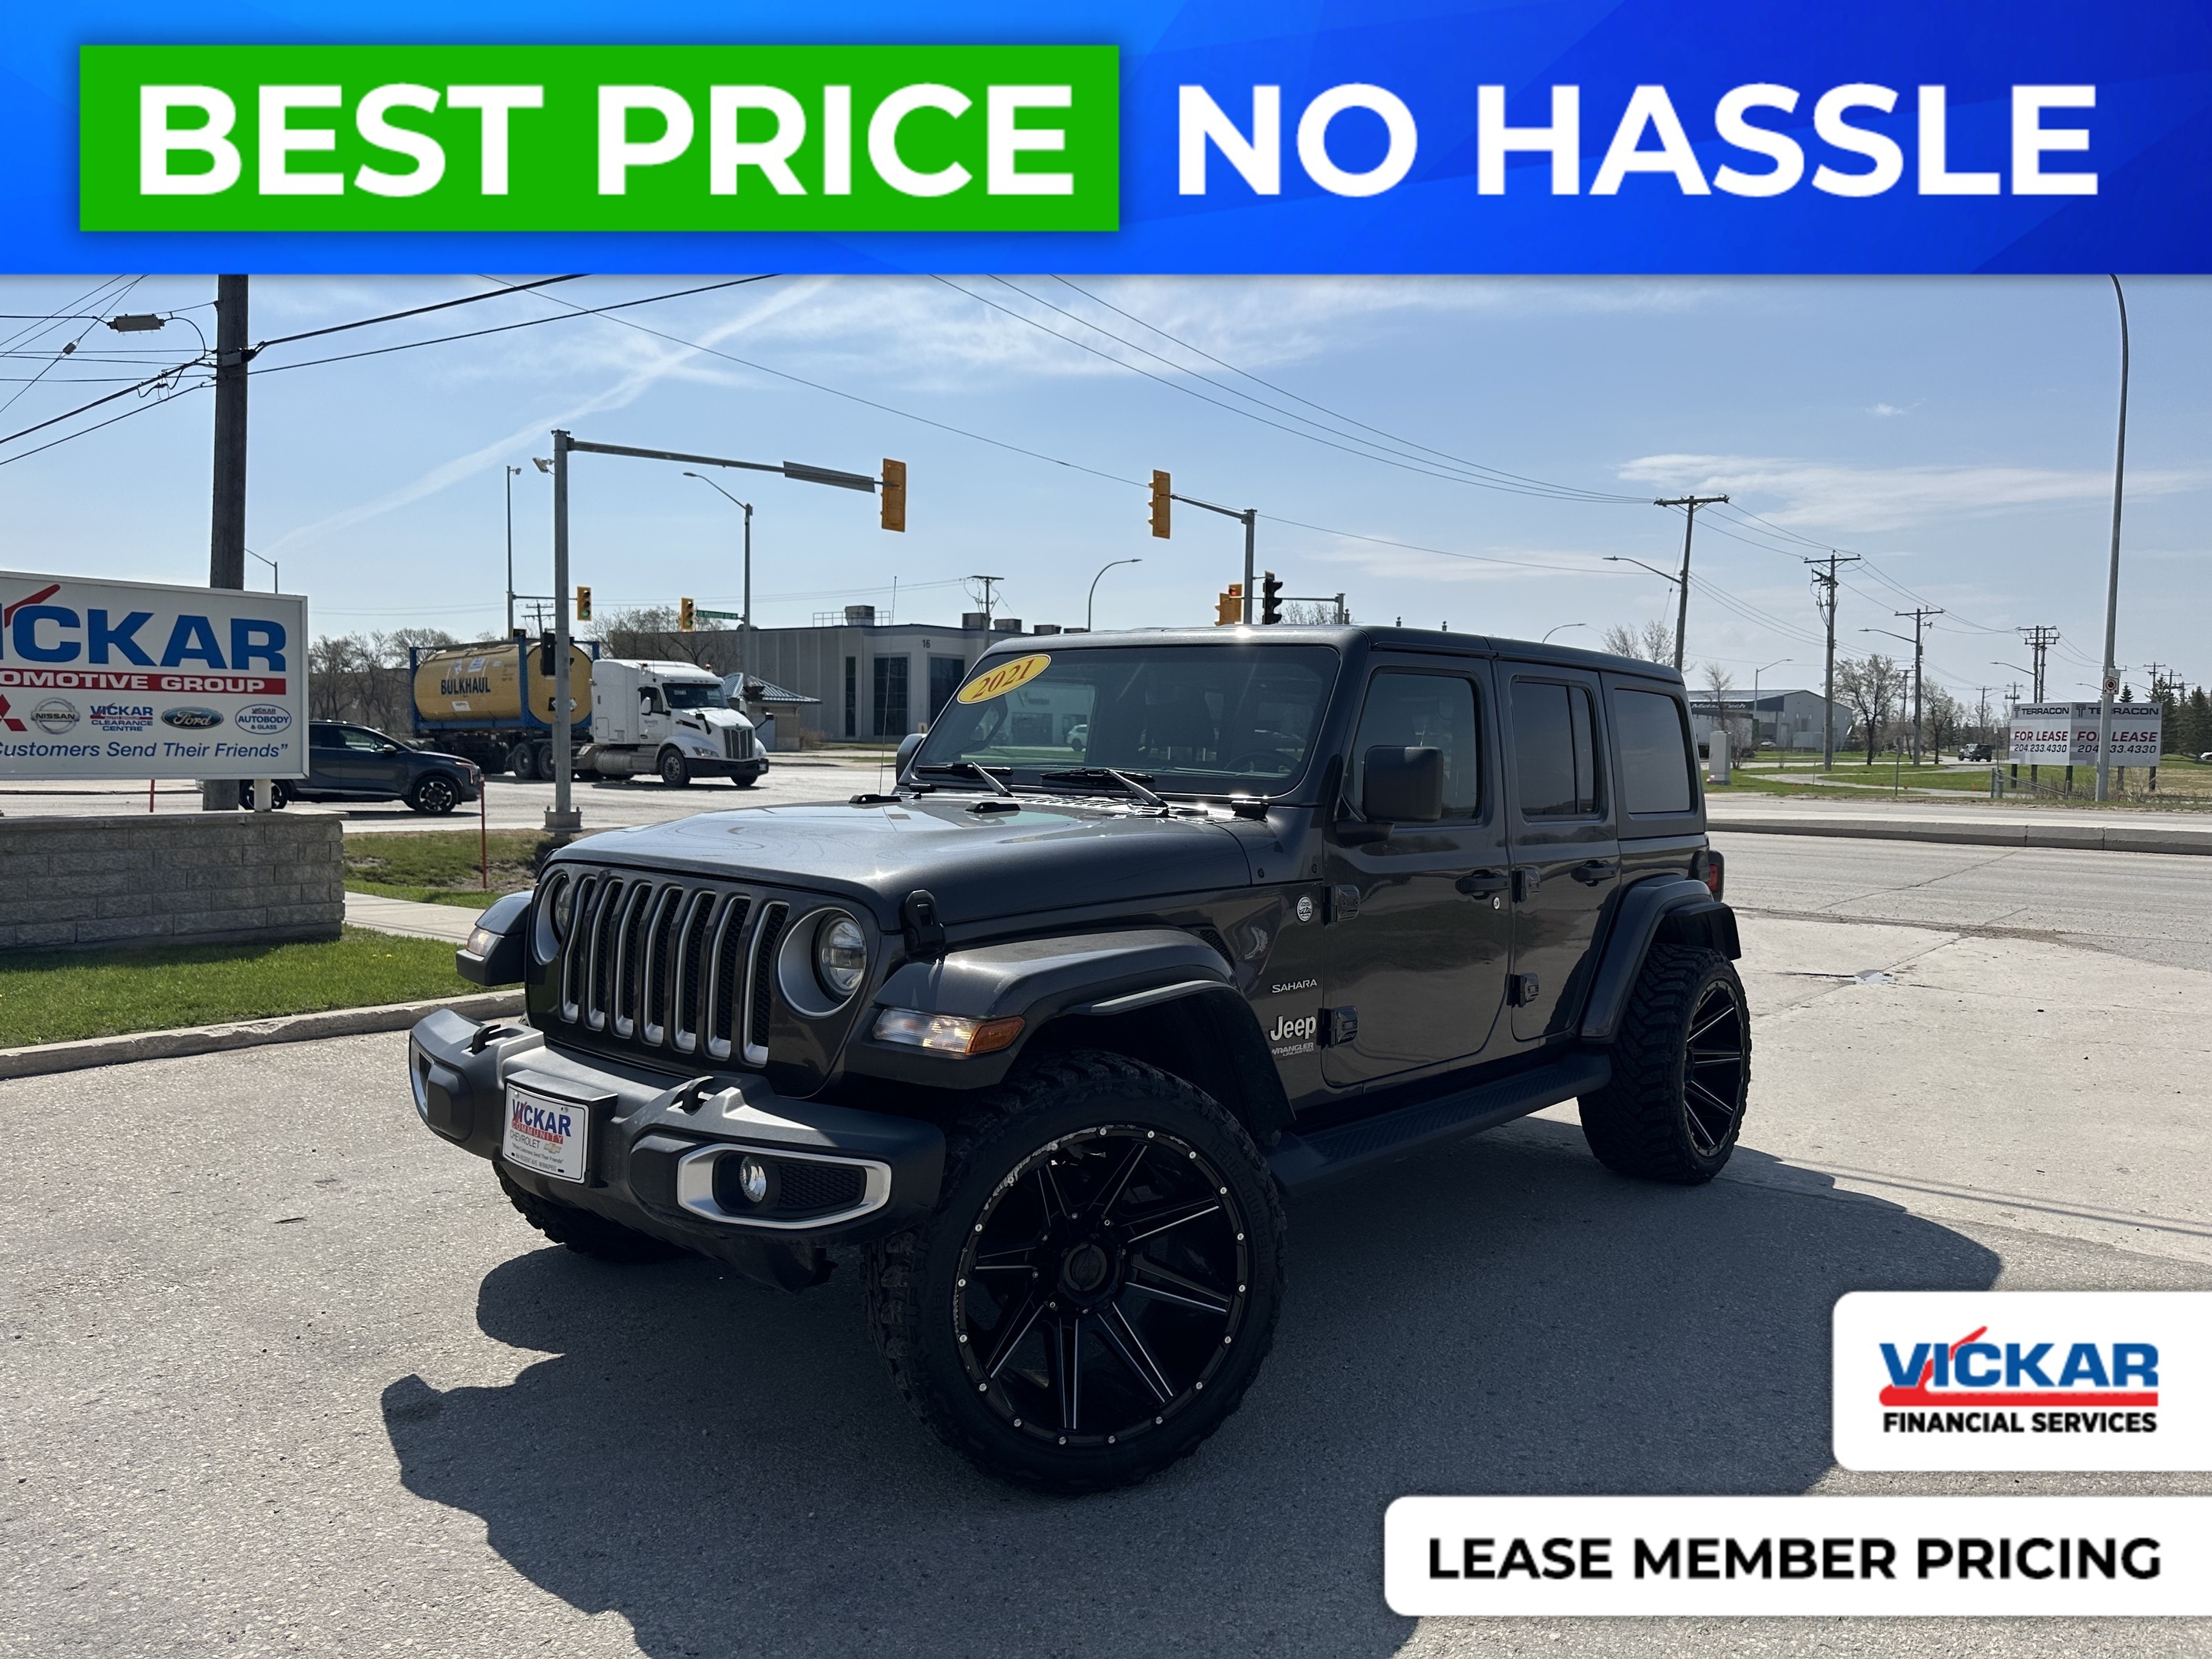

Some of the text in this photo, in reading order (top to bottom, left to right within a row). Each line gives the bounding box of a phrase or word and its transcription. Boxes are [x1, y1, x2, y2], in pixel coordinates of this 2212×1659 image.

[0, 603, 286, 671] CKAR
[922, 639, 930, 648] 16
[161, 676, 265, 693] GROUP
[441, 677, 491, 695] BULKHAUL
[971, 658, 1035, 700] 2021
[90, 704, 154, 716] VICKAR
[2021, 707, 2069, 715] TERRACON
[174, 710, 211, 727] Ford
[2014, 731, 2068, 741] FOR LEASE
[2077, 731, 2158, 742] FO LEASE
[107, 741, 157, 757] Send
[164, 742, 210, 757] Their
[2014, 743, 2067, 753] 204.233.4330
[2078, 744, 2157, 753] 20433.4330
[1272, 979, 1317, 993] SAHARA
[1270, 1015, 1316, 1041] Jeep
[512, 1098, 571, 1137] VICKAR
[509, 1129, 541, 1149] CHEVROLET
[512, 1121, 563, 1144] COMMUNITY
